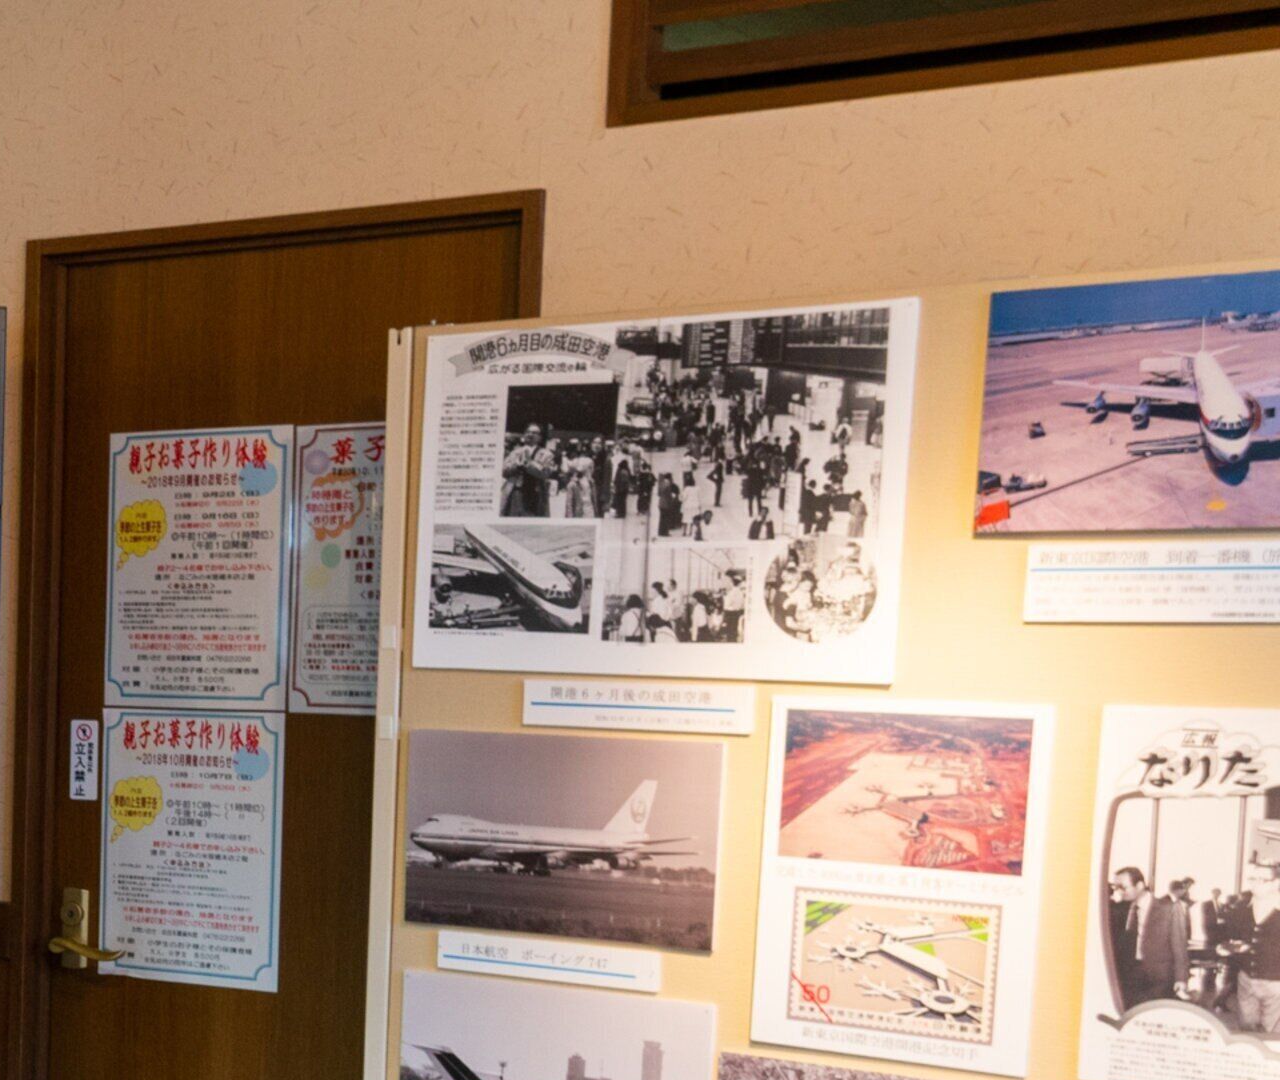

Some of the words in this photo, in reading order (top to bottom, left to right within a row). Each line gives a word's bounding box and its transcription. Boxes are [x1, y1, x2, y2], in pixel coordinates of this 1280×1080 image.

[128, 437, 269, 475] 親子お菓子作り体験
[122, 718, 261, 756] 親子お菓子作り体験
[73, 742, 86, 797] 立入禁止
[1139, 750, 1268, 790] なりた
[460, 941, 510, 959] 日本航空
[521, 948, 609, 970] ボーイング747
[800, 984, 831, 1004] 50
